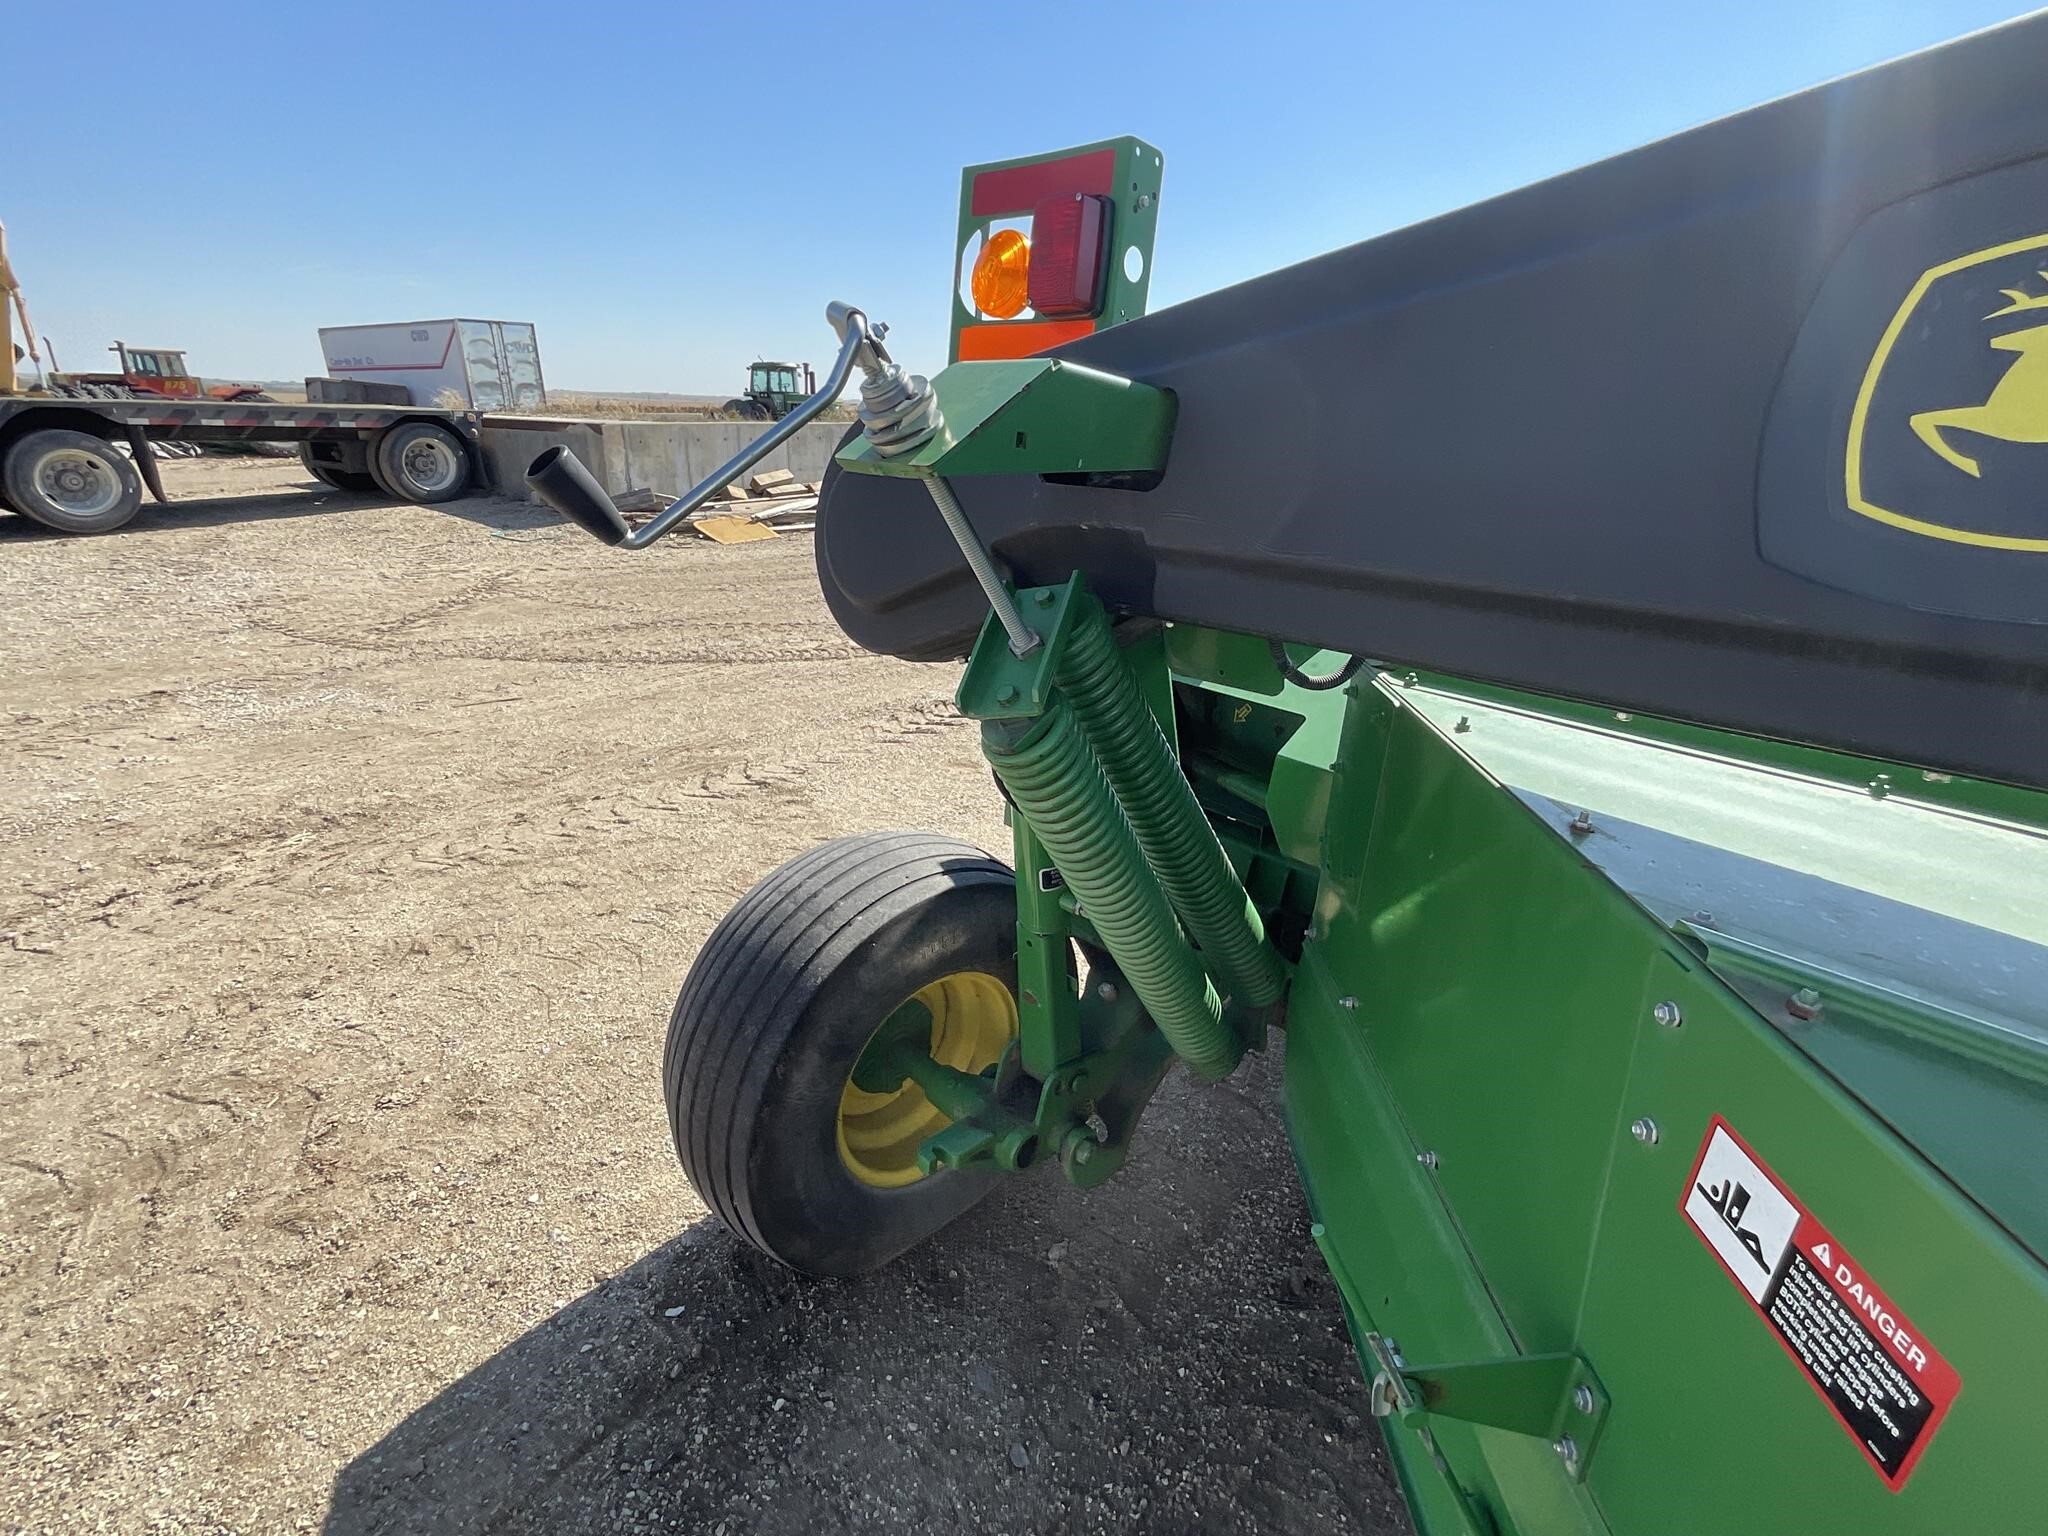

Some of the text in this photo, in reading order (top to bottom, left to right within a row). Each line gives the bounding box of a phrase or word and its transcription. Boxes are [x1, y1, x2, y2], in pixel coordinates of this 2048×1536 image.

[505, 342, 536, 353] CWD
[1769, 1306, 1832, 1388] harvesting unit
[1775, 1297, 1864, 1411] working under raised
[1779, 1285, 1805, 1319] BOTH
[1804, 1318, 1841, 1362] cylinder
[1839, 1362, 1867, 1397] stops
[1866, 1394, 1900, 1438] before
[1784, 1277, 1830, 1334] completely
[1829, 1332, 1850, 1357] and
[1848, 1355, 1884, 1400] engage
[1795, 1253, 1920, 1407] To avoid a serious crushing
[1816, 1299, 1848, 1337] extend
[1846, 1334, 1862, 1355] lift
[1860, 1352, 1906, 1409] cylinders
[1834, 1264, 1927, 1373] DANGER
